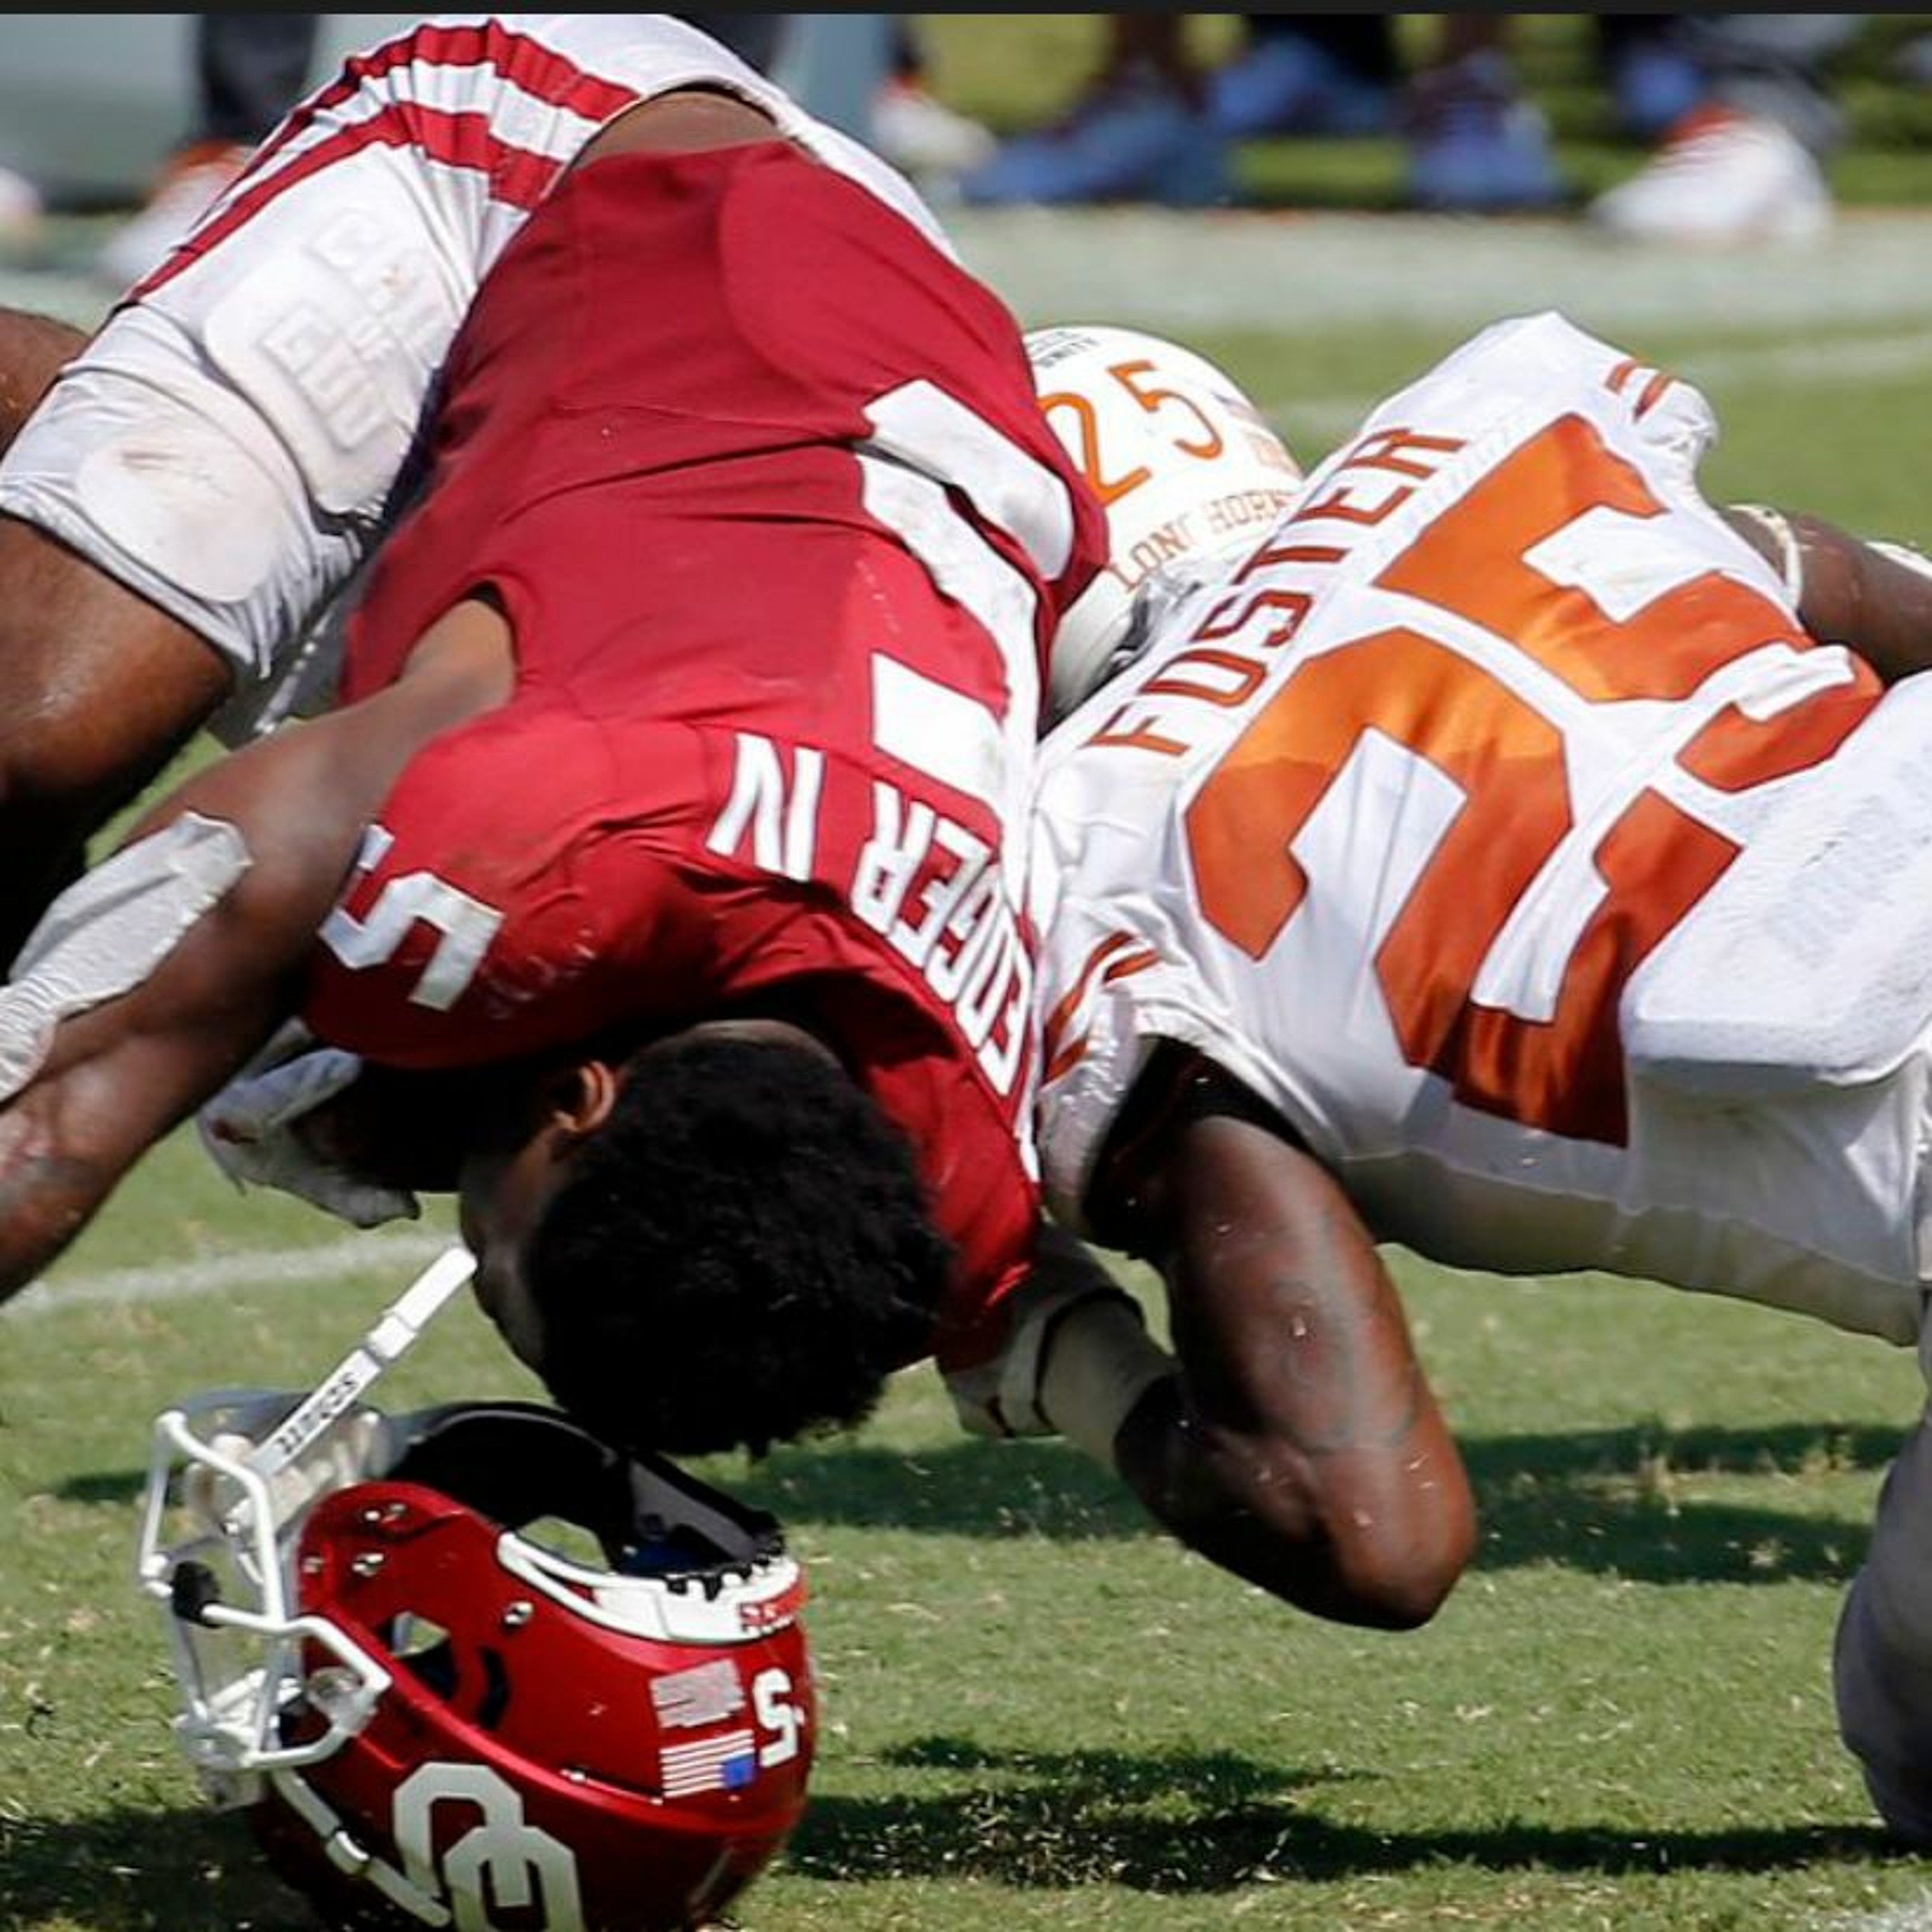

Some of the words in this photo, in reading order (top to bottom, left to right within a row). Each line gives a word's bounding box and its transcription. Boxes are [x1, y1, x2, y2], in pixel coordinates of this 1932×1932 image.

[1036, 359, 1223, 509] 25
[1077, 428, 1470, 759] FOSTER
[1184, 411, 1886, 1150] 25
[317, 823, 507, 1013] 5
[752, 1668, 806, 1768] 5
[393, 1761, 587, 1932] OU
